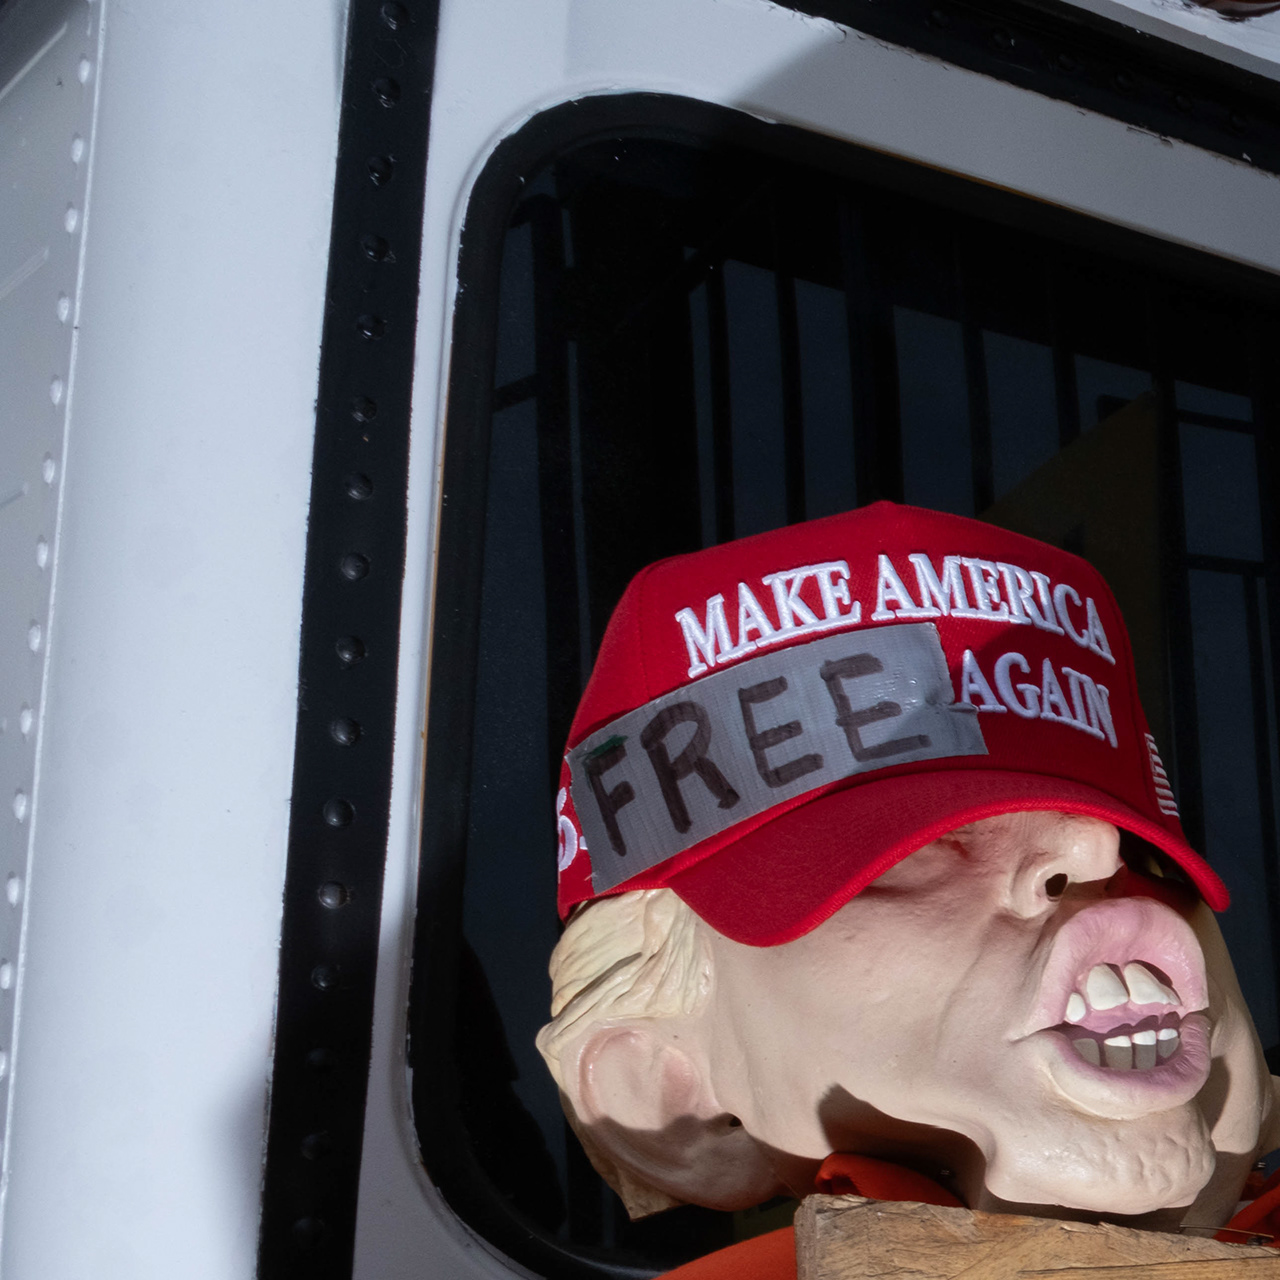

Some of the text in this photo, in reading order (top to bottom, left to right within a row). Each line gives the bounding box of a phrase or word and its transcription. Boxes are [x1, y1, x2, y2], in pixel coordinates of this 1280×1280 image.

[675, 553, 1117, 678] MAKE AMERICA
[582, 652, 933, 857] FREE
[952, 649, 1119, 750] AGAIN
